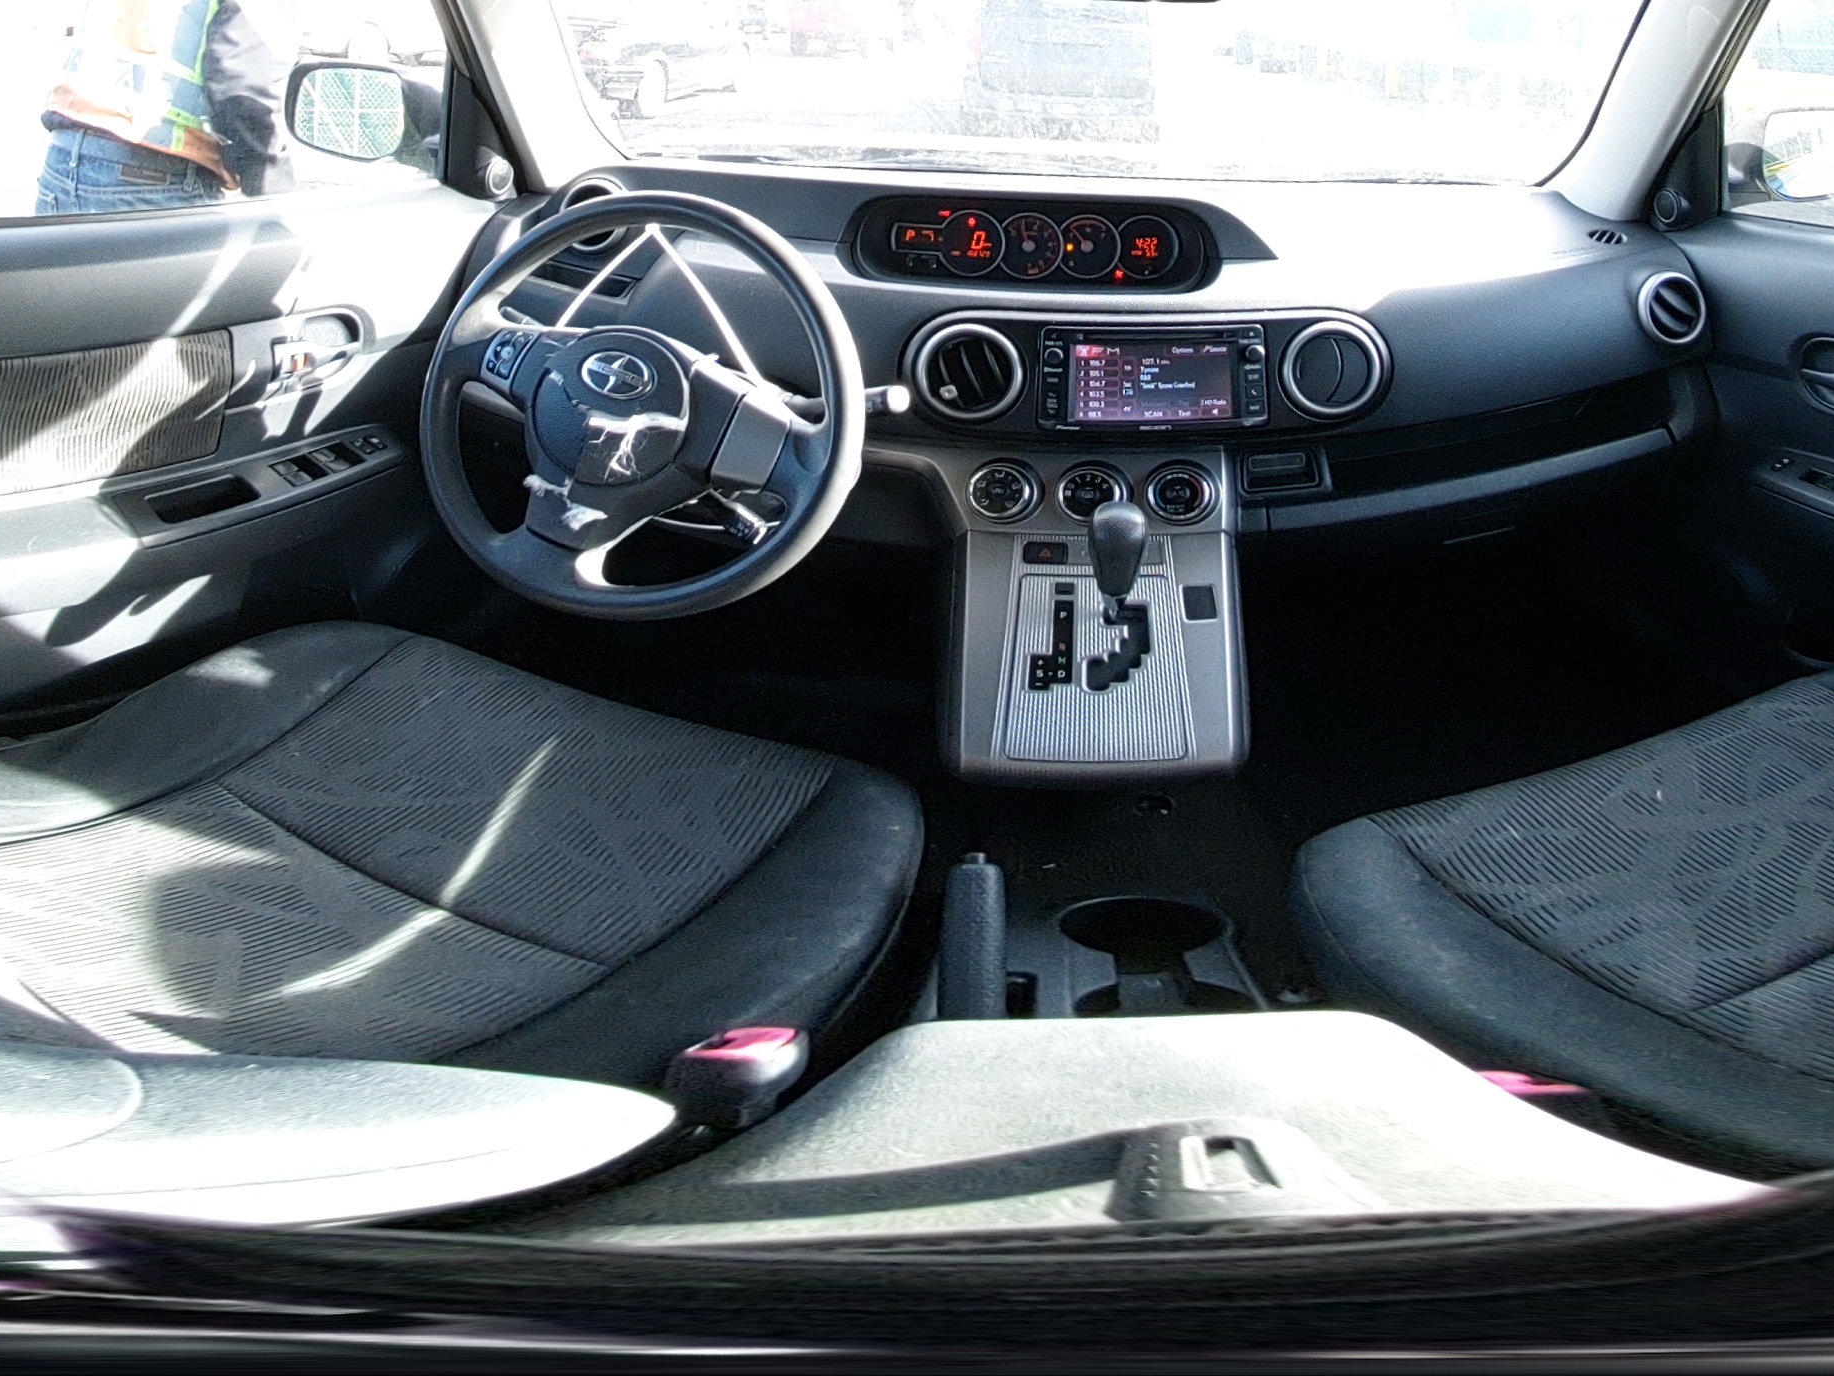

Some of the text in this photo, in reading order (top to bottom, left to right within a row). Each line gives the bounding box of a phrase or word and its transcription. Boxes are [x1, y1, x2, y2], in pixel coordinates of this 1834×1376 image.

[1171, 346, 1194, 355] Options
[1144, 409, 1163, 417] SCAN
[1057, 669, 1066, 678] D
